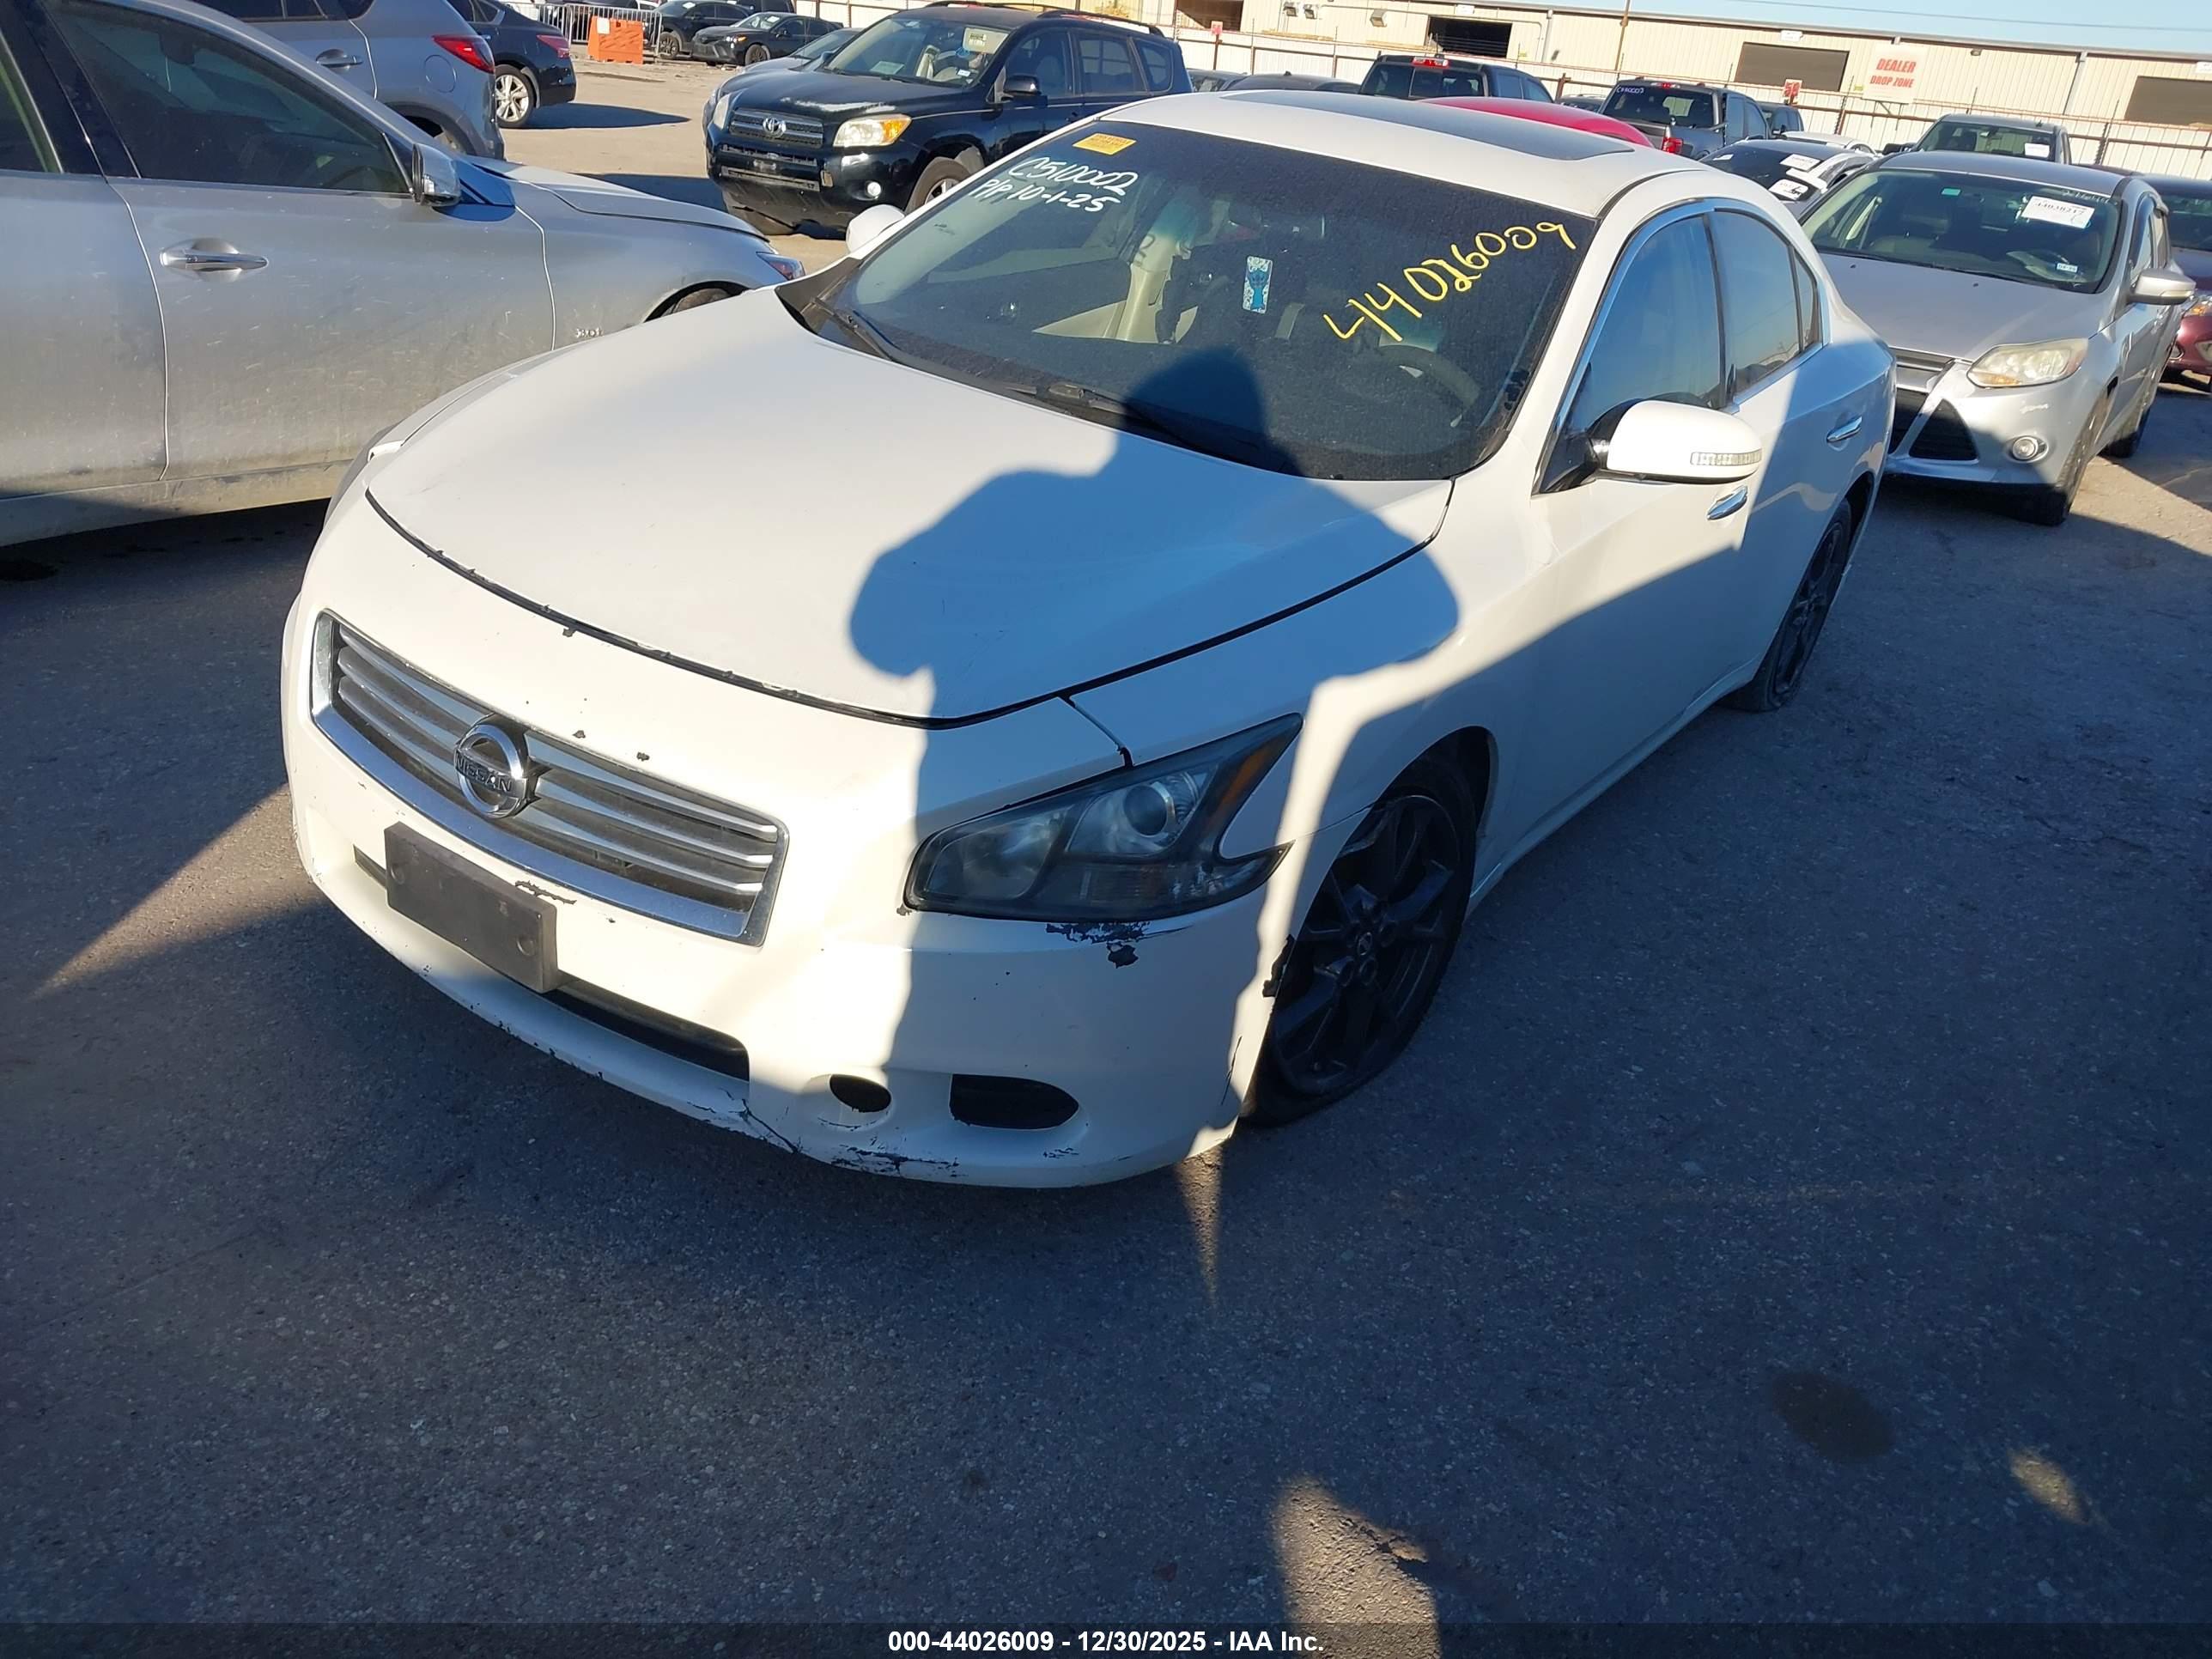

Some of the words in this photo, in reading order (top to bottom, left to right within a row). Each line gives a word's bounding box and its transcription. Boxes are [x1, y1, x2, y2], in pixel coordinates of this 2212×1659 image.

[1876, 58, 1917, 73] DEALER
[1869, 76, 1893, 85] DROP
[1893, 77, 1915, 88] ZONE
[1006, 184, 1121, 212] 10-1-25
[1323, 222, 1577, 342] 44026009
[455, 755, 513, 793] NISSAN
